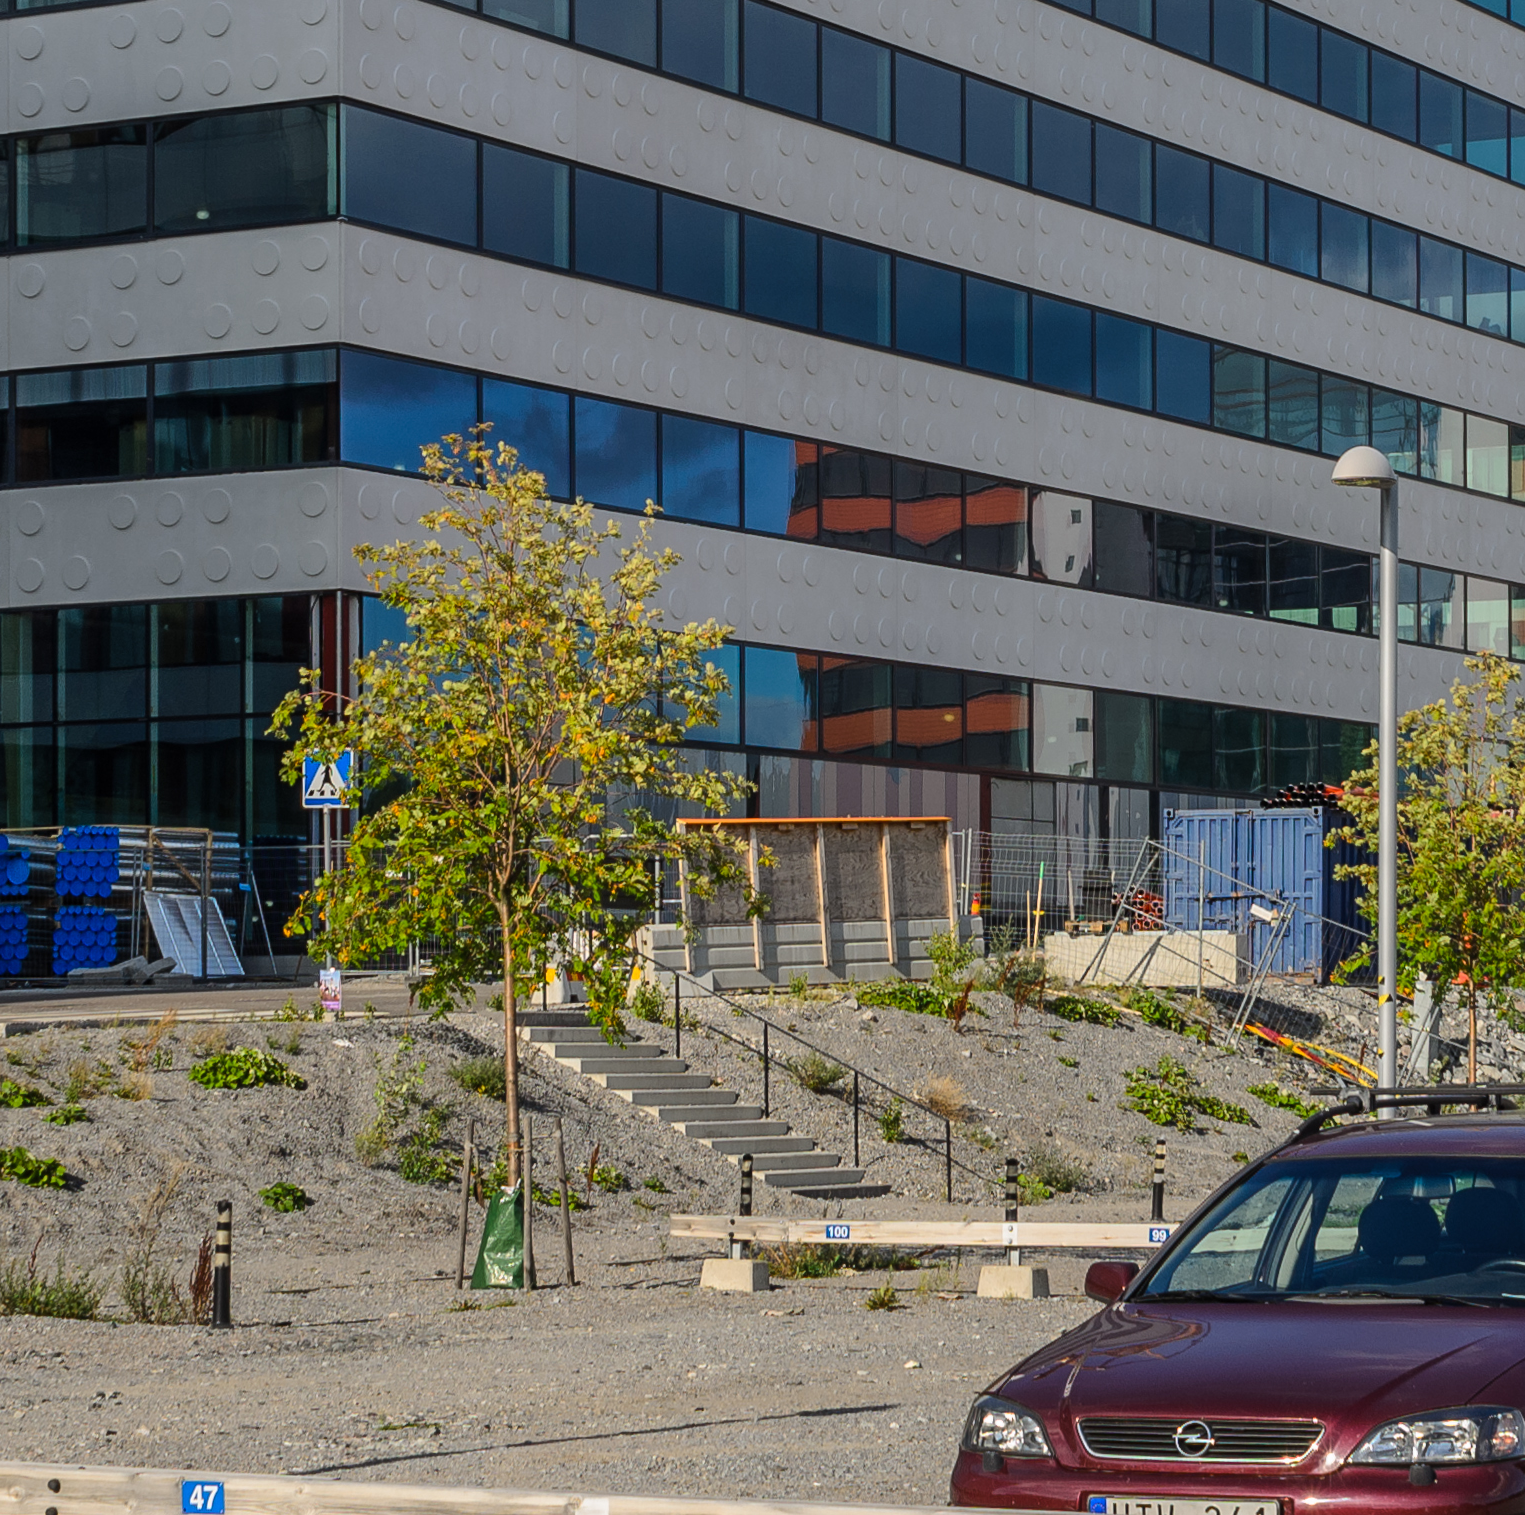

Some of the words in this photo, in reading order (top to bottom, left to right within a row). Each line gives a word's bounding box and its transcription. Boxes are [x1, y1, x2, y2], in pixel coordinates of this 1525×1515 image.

[829, 1226, 848, 1237] 100
[1152, 1229, 1167, 1241] 99
[189, 1484, 218, 1510] 47
